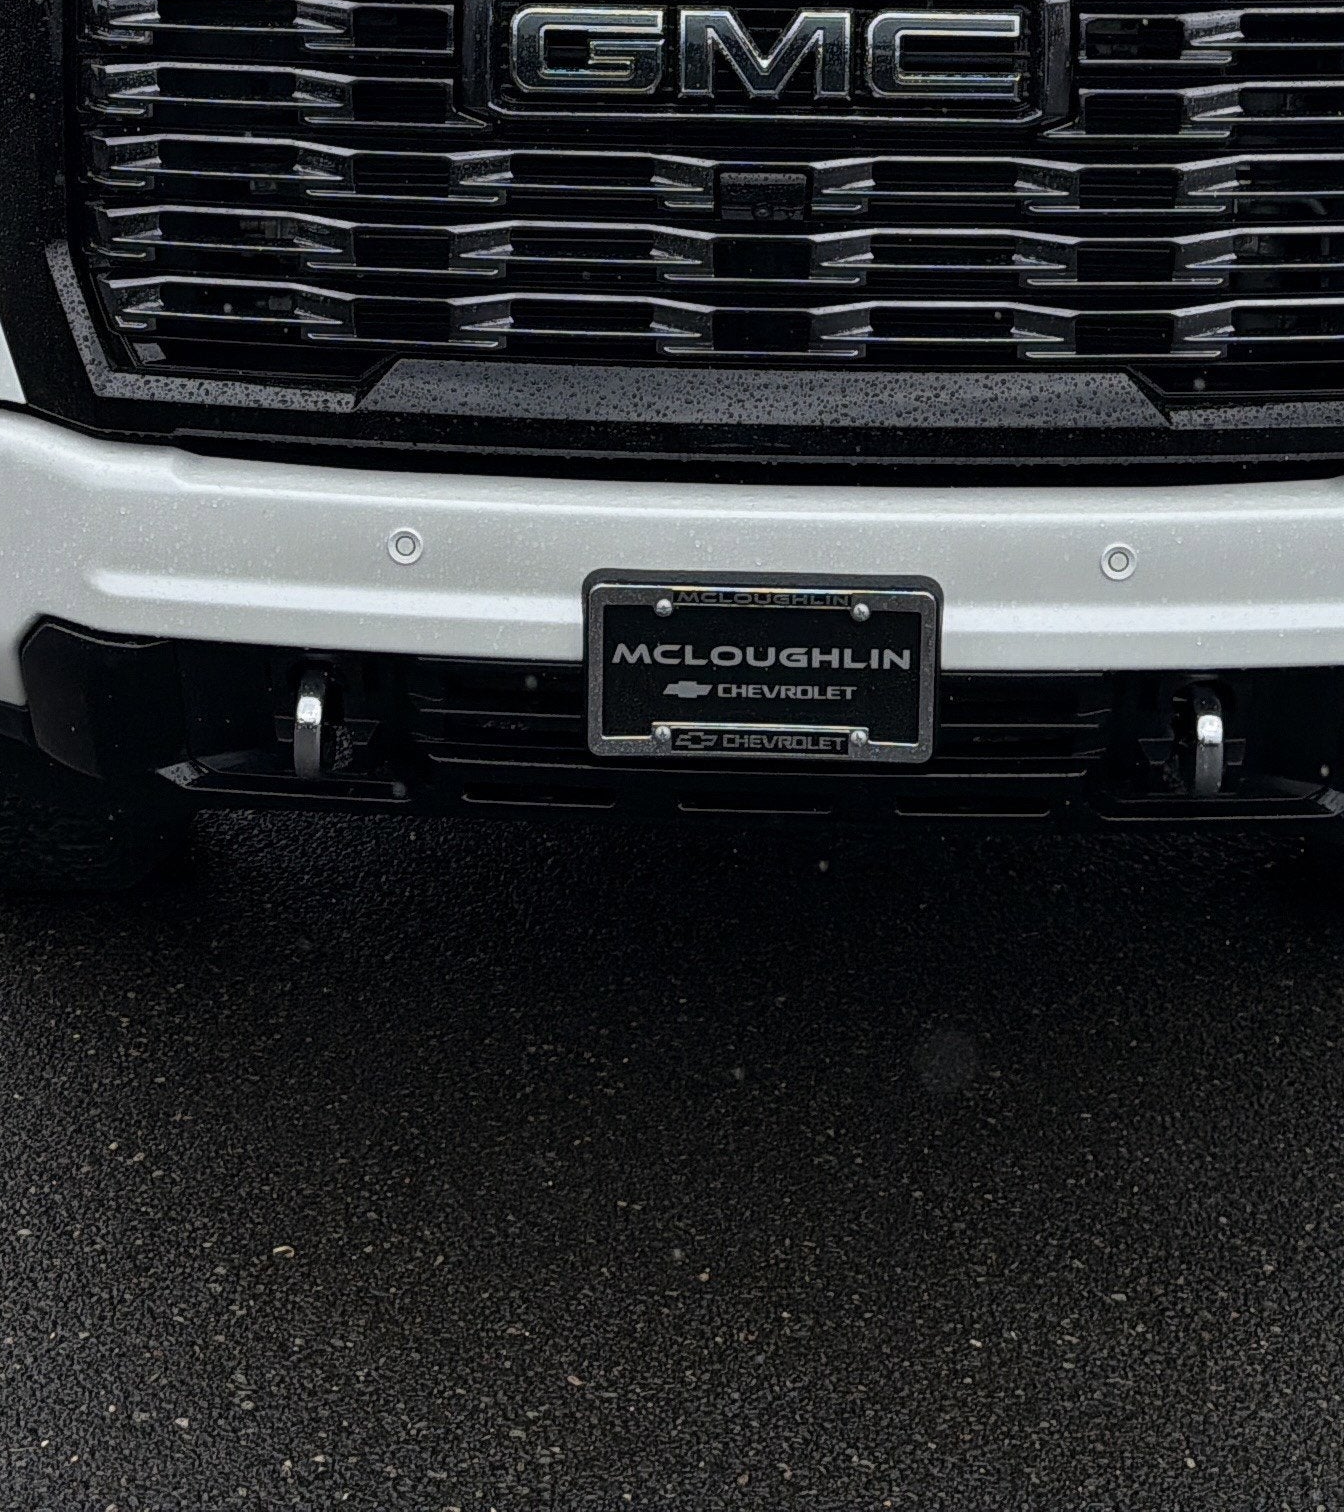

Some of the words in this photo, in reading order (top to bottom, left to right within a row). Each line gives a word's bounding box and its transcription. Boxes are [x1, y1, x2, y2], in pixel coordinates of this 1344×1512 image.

[510, 5, 1022, 101] GMC
[676, 591, 850, 607] MCLOUGHLIN
[611, 643, 911, 670] MCLOUGHLIN
[717, 683, 857, 700] CHEVROLET
[722, 734, 846, 750] CHEVROLET
